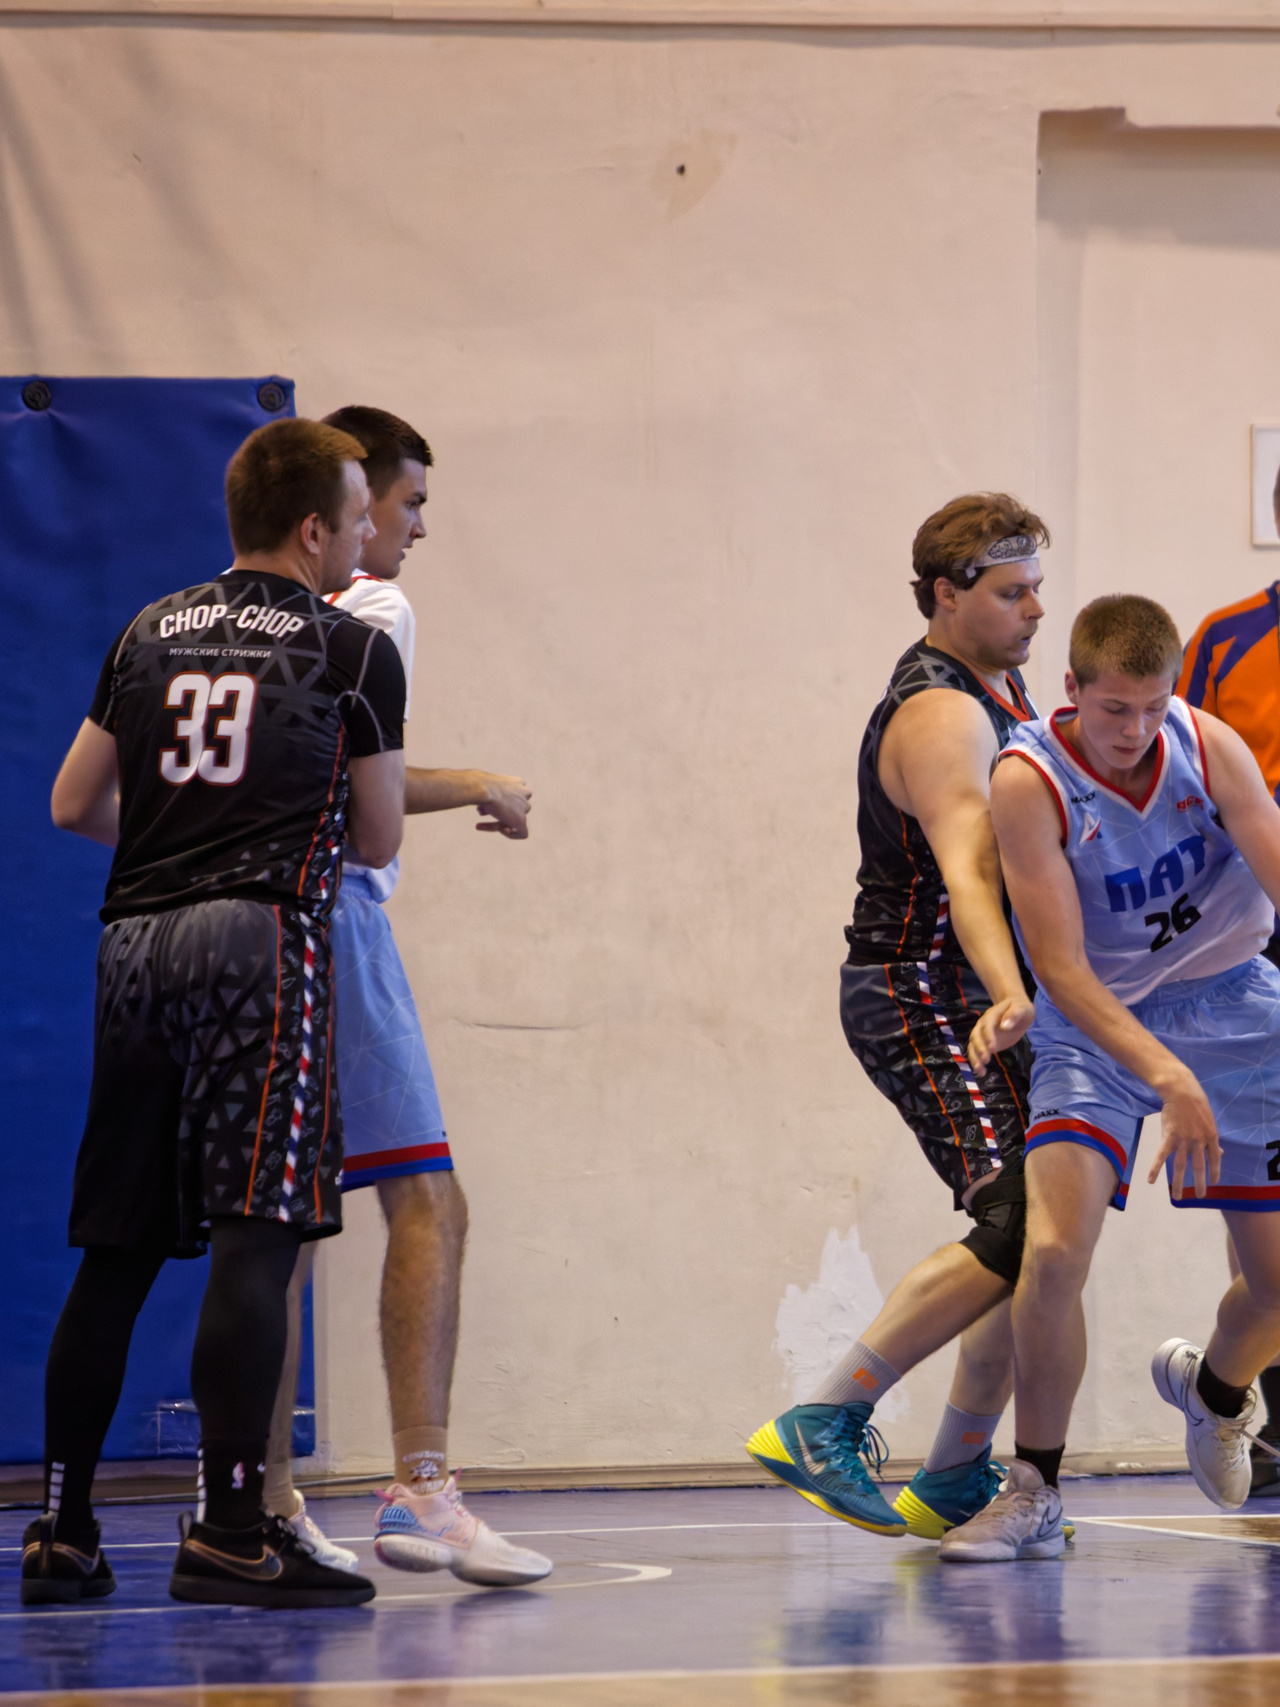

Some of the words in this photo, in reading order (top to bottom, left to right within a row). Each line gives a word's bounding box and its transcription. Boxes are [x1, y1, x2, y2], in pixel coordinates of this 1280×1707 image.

[159, 604, 305, 639] CHOP-CHOP
[168, 647, 219, 657] МУЖСКИЕ
[221, 648, 272, 659] СТРИЖКИ
[158, 671, 257, 786] 33
[1144, 892, 1202, 953] 26
